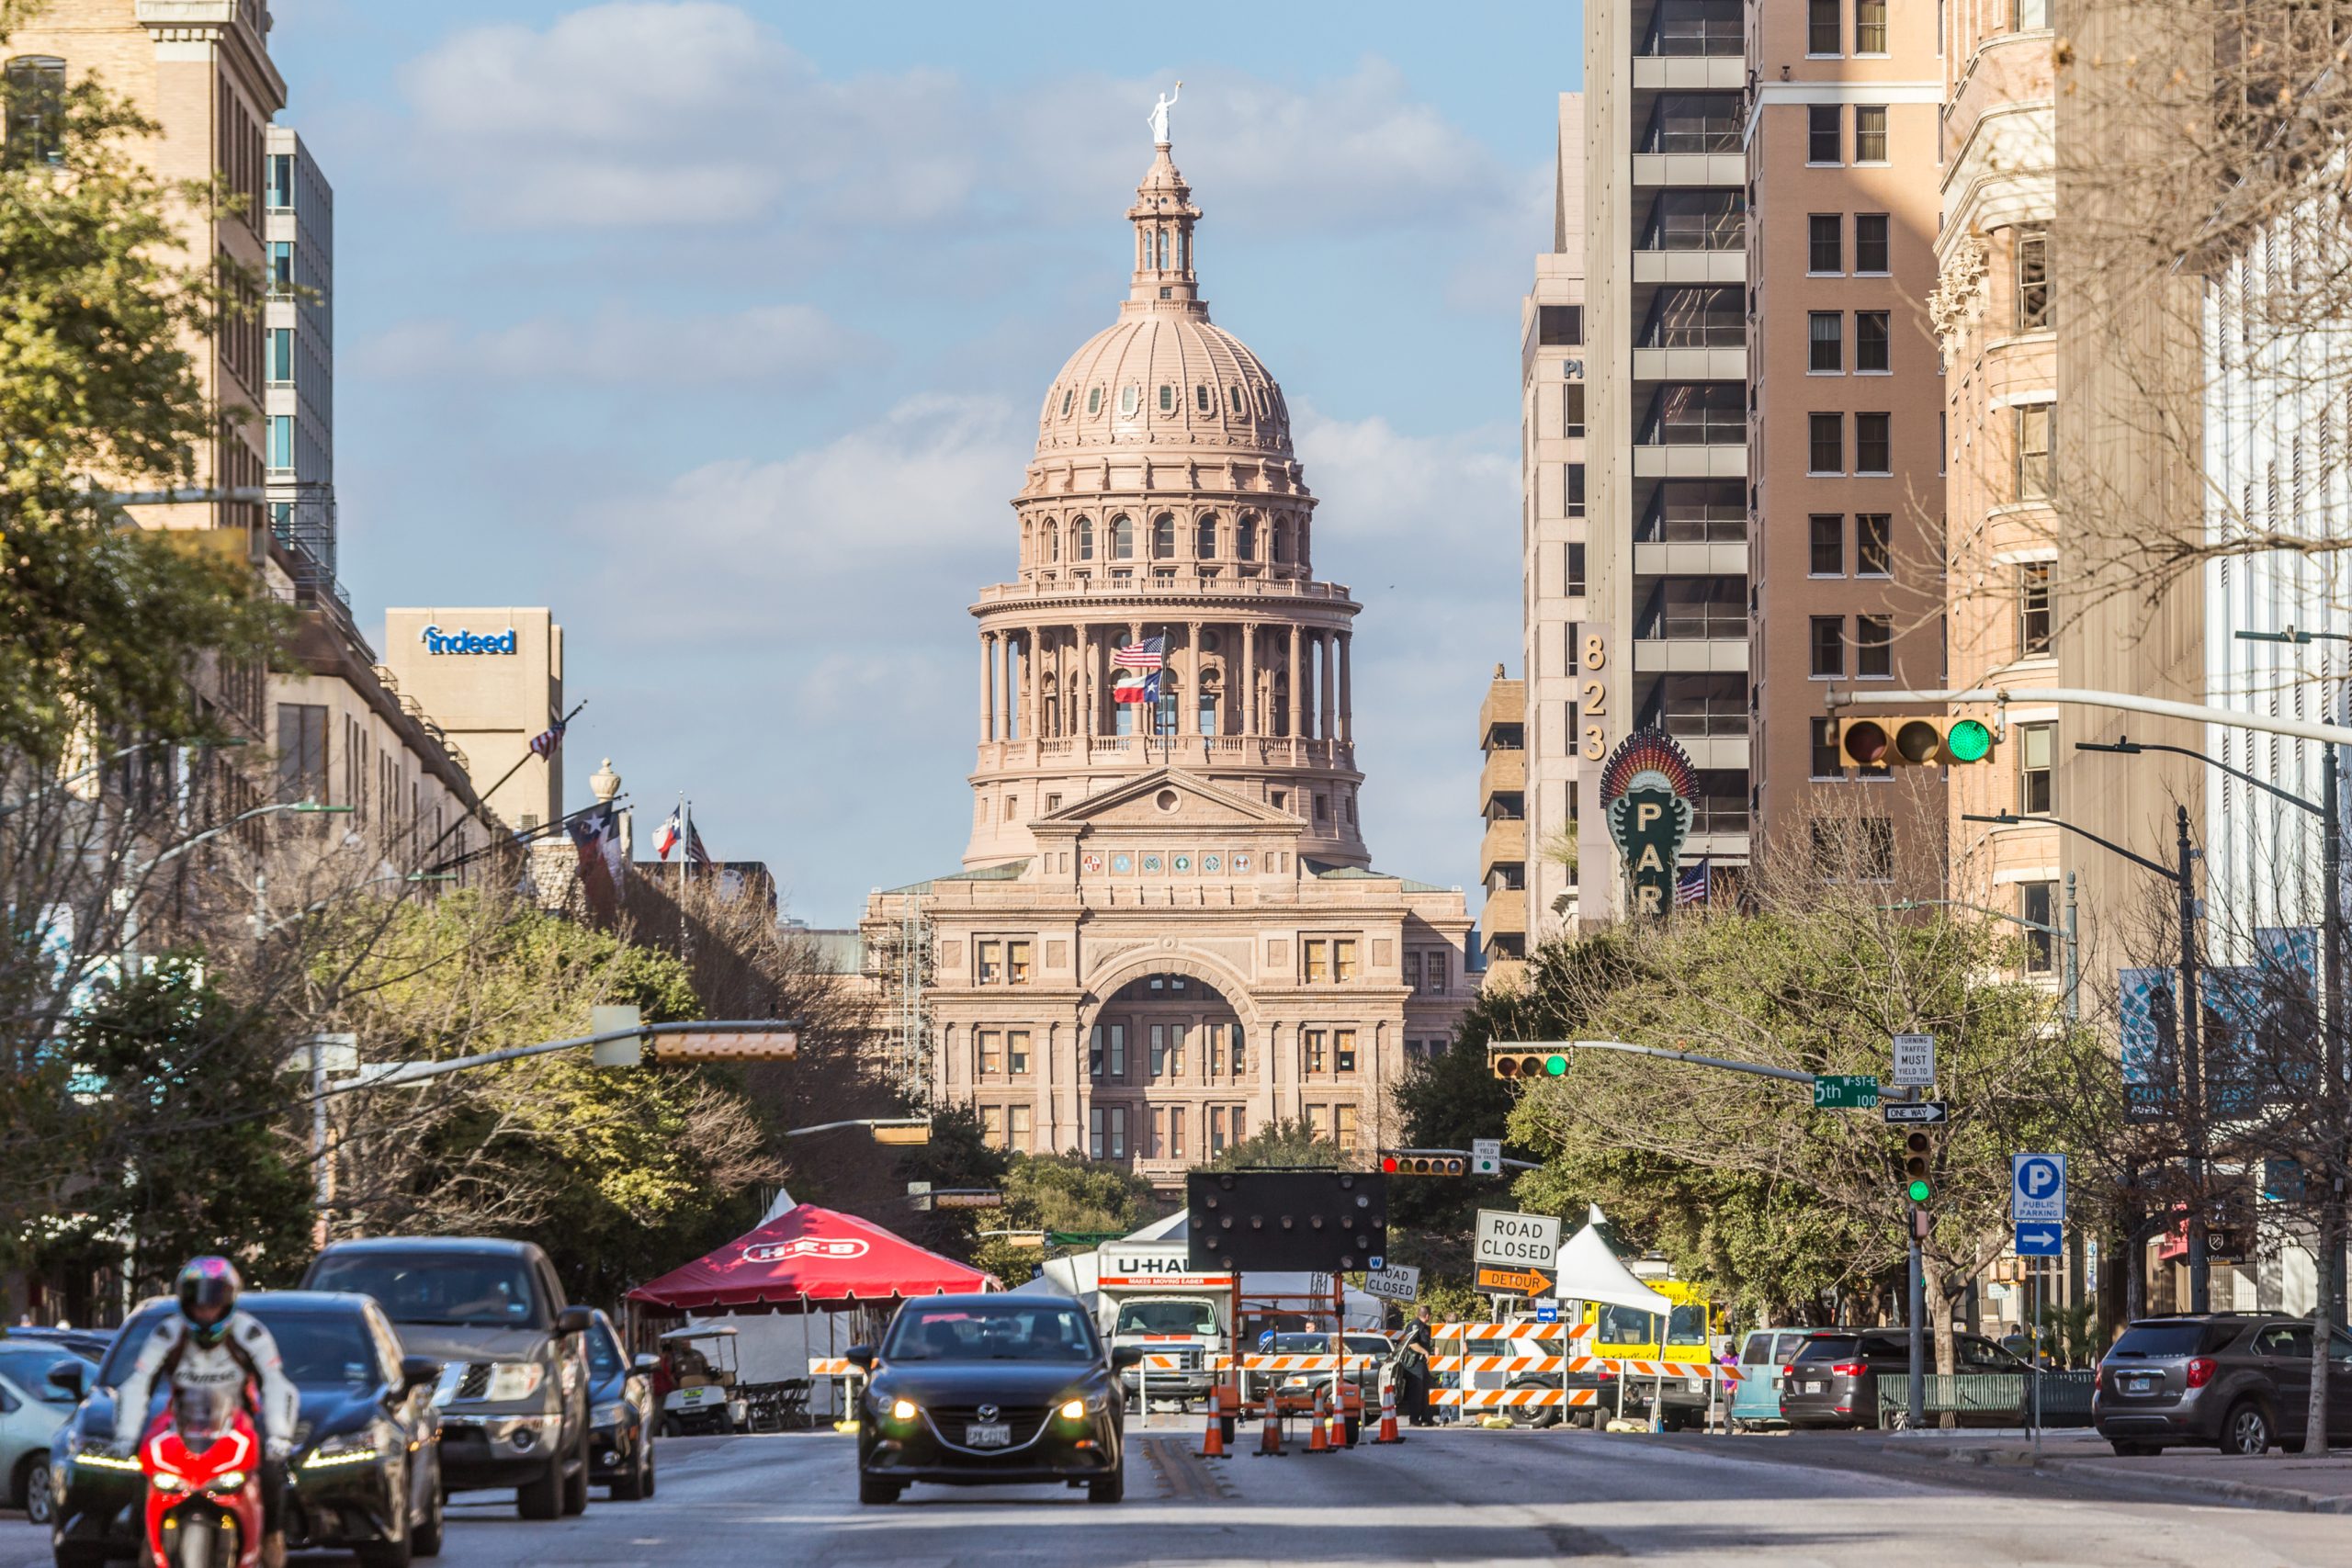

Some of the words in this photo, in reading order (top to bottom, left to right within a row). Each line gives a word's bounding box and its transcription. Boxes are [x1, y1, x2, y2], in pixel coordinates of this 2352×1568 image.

[423, 626, 515, 654] indeed
[1583, 634, 1606, 761] 823
[1901, 1055, 1927, 1066] MUST
[1815, 1080, 1841, 1103] 5th
[1843, 1077, 1876, 1087] W-ST-E
[1857, 1095, 1876, 1107] 100
[1890, 1109, 1906, 1117] ONE
[1911, 1109, 1928, 1117] WAY
[1493, 1219, 1543, 1238] ROAD
[760, 1241, 855, 1258] H-E-B
[1482, 1239, 1551, 1260] CLOSED
[1369, 1279, 1413, 1296] CLOSED
[1491, 1273, 1541, 1289] DETOUR
